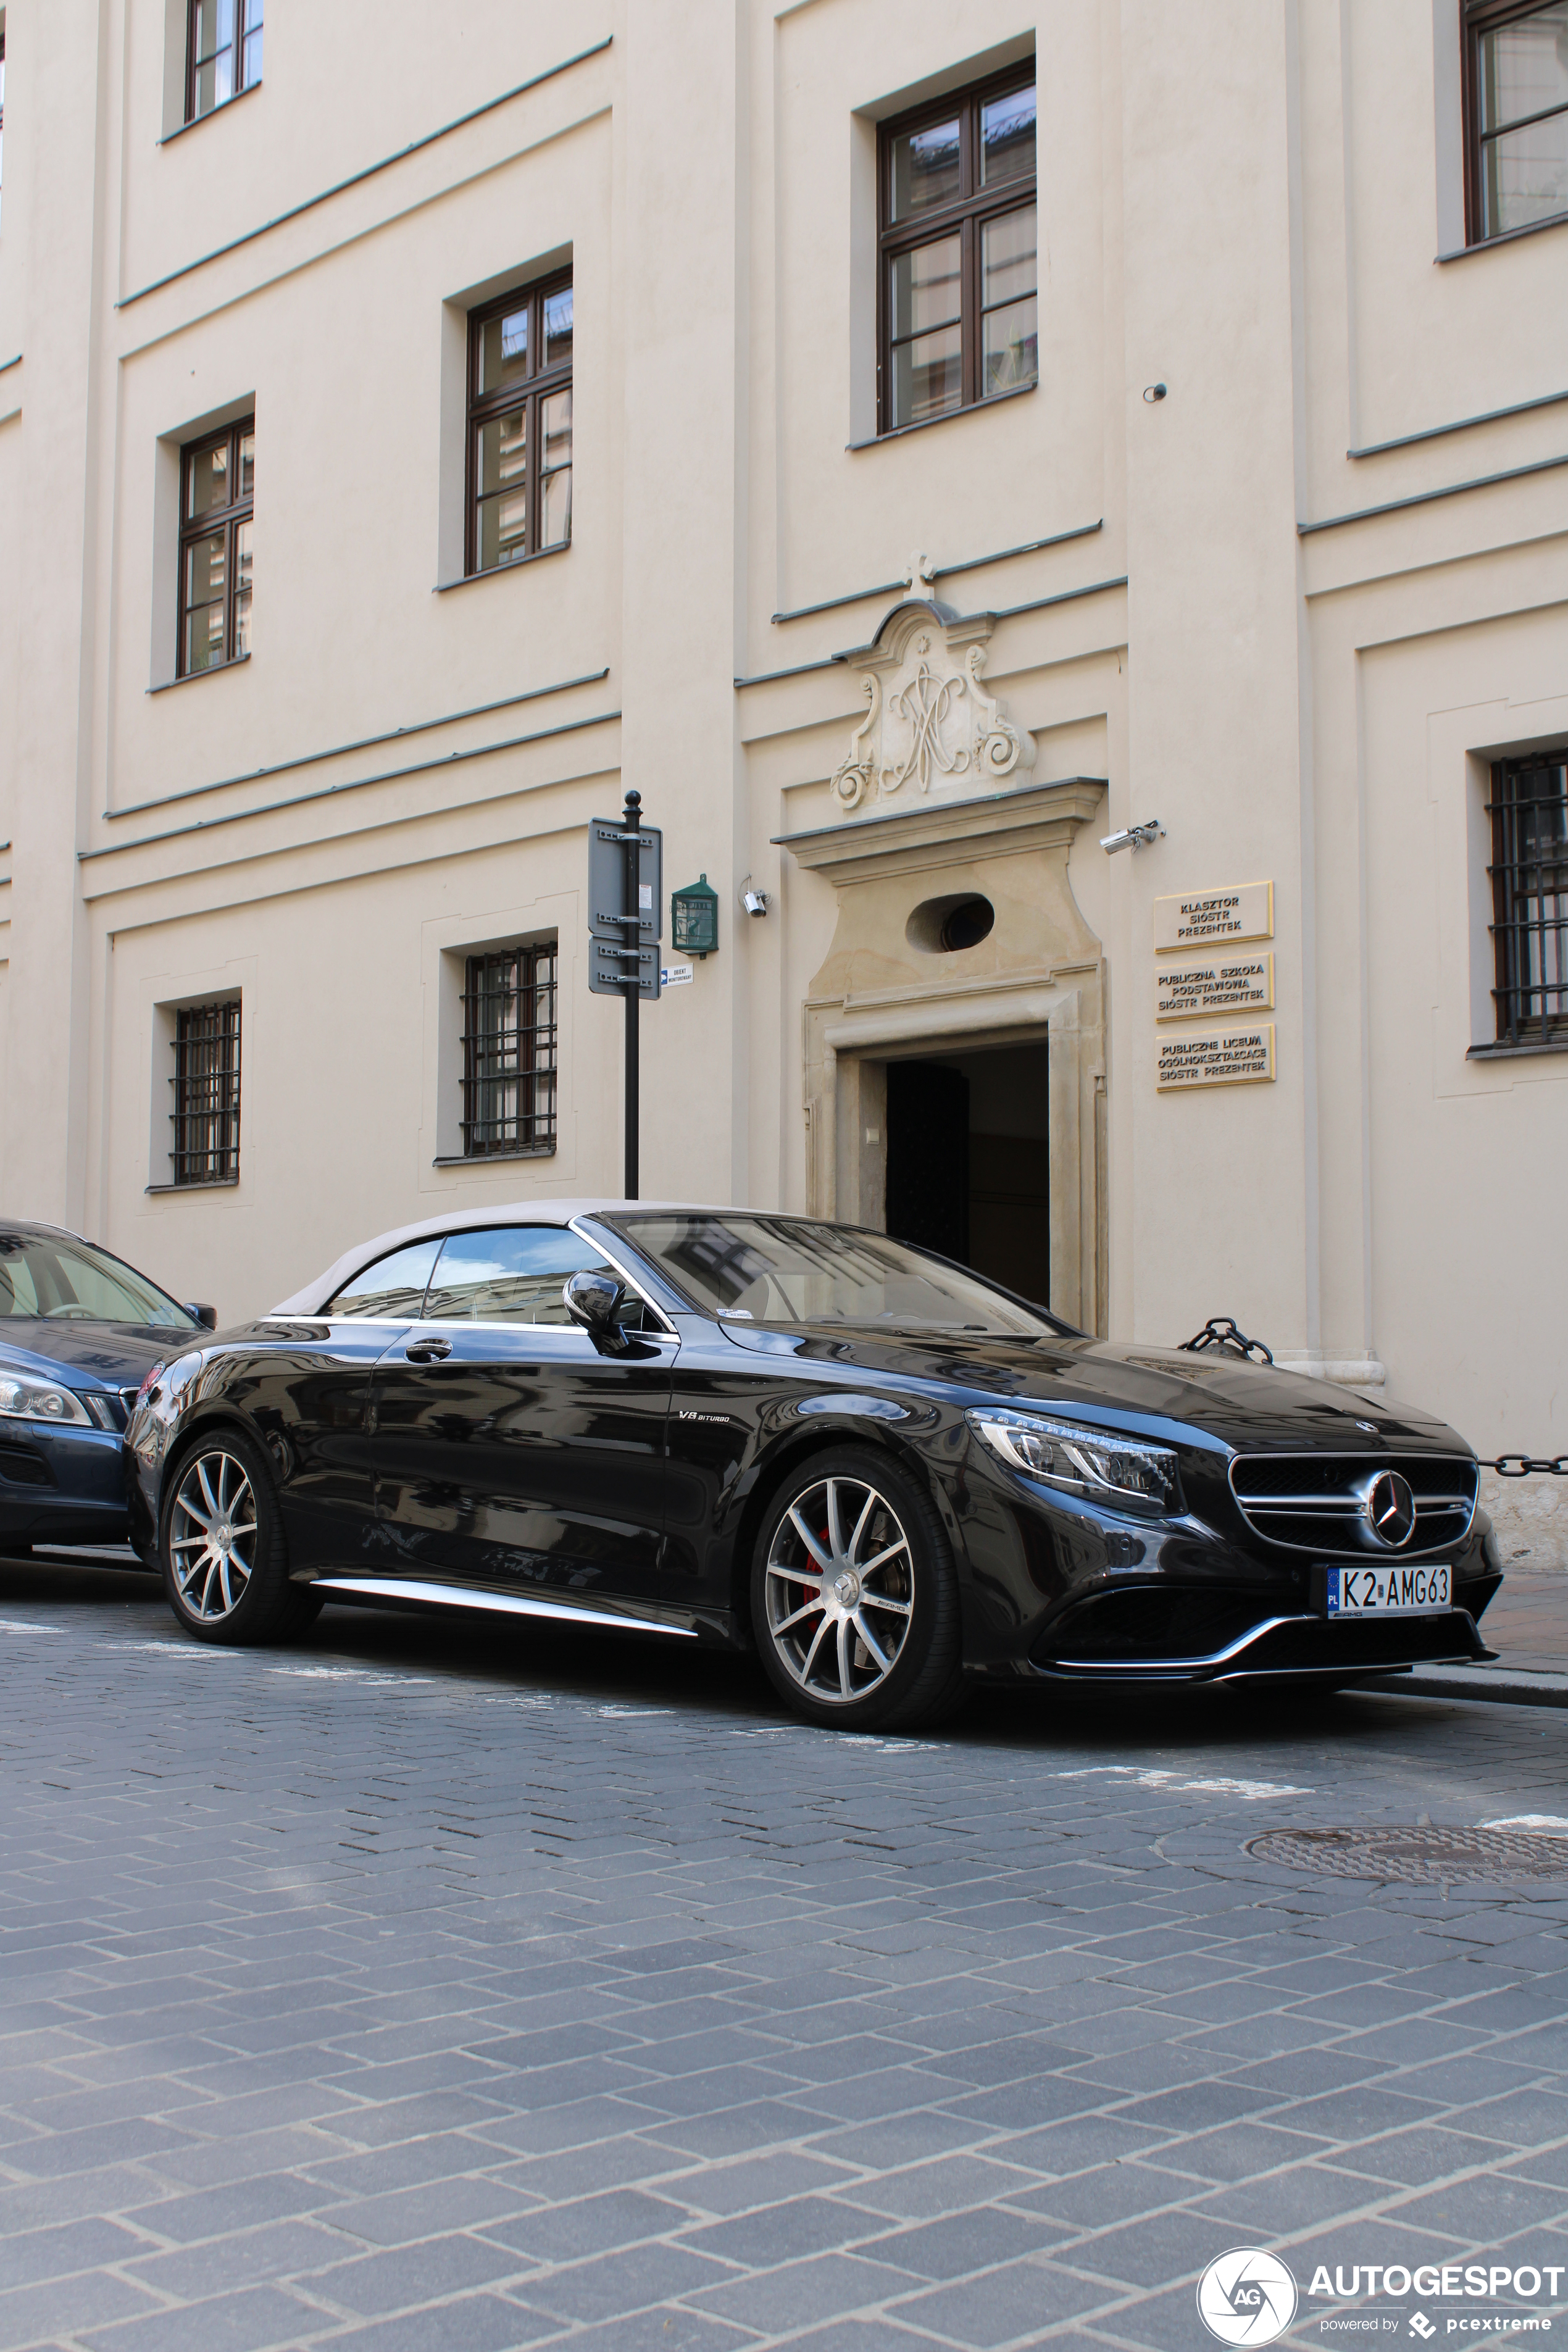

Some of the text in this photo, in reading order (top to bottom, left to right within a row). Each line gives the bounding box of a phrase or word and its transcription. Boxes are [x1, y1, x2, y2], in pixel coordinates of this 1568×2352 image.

[1180, 896, 1239, 914] KLASZTOR
[1190, 910, 1230, 924] SIÓSTR
[1178, 920, 1241, 938] PREZENTEK
[673, 968, 686, 976] OBIEKT
[1158, 964, 1264, 986] PUBLICZNA SZKOŁA
[1172, 978, 1249, 996] PODSTAWOWA
[1159, 989, 1264, 1011] SIÓSTR PREZENTEK
[1162, 1035, 1261, 1056] PUBLICZNE LICEUM
[1158, 1048, 1267, 1069] OGÓLNOKSZTAŁCĄCE
[1160, 1061, 1265, 1081] SIÓSTR PREZENTEK
[679, 1411, 730, 1422] V8 BITURBO
[1343, 1569, 1448, 1608] K2 AMG63
[886, 1603, 906, 1612] AMG
[1328, 1595, 1338, 1605] PL
